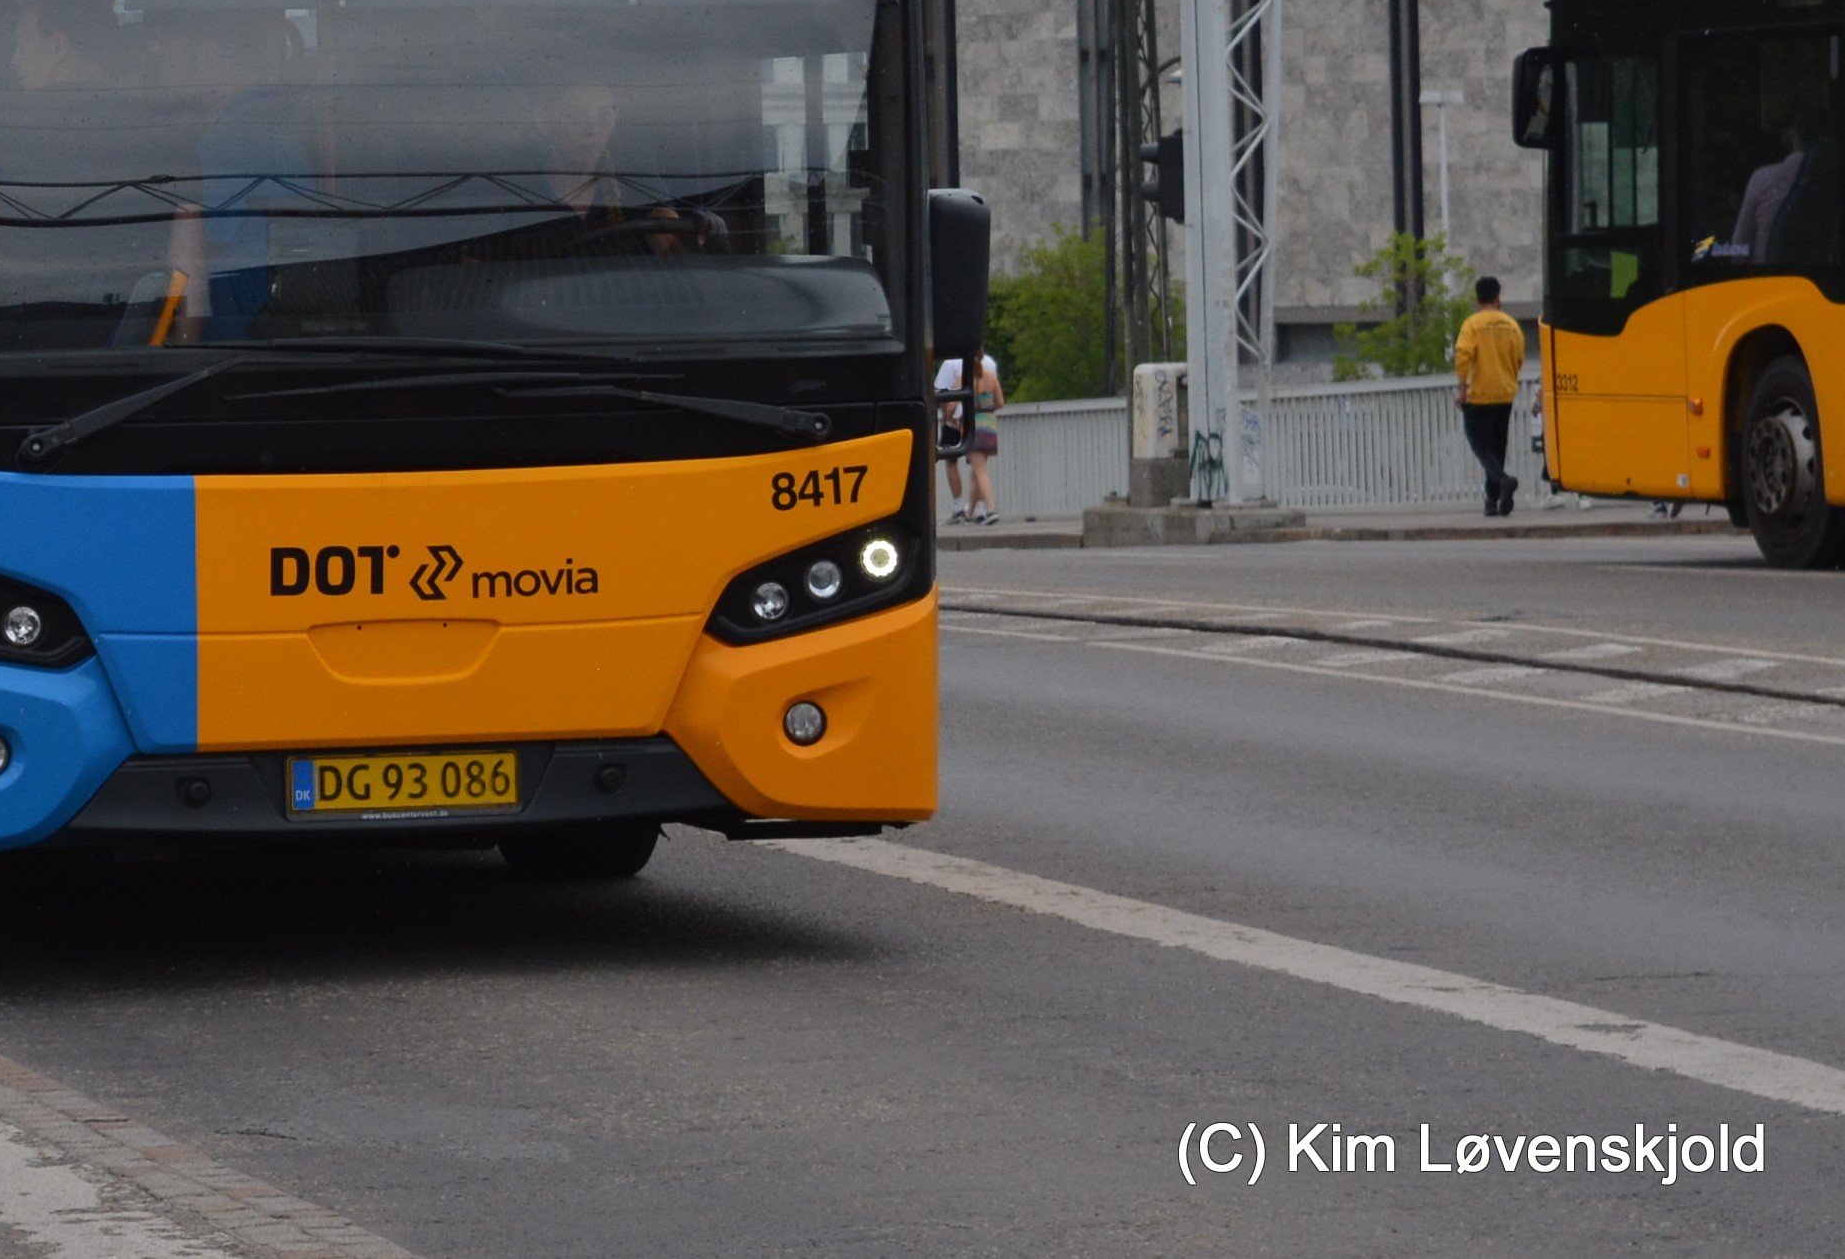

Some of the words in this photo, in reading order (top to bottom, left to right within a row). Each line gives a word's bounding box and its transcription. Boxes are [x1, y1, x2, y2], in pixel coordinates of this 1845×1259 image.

[770, 465, 868, 511] 8417
[270, 545, 400, 596] DOT
[471, 558, 599, 599] movia
[295, 790, 311, 801] DK
[318, 764, 371, 801] DG
[382, 763, 427, 800] 93
[441, 759, 510, 798] 086
